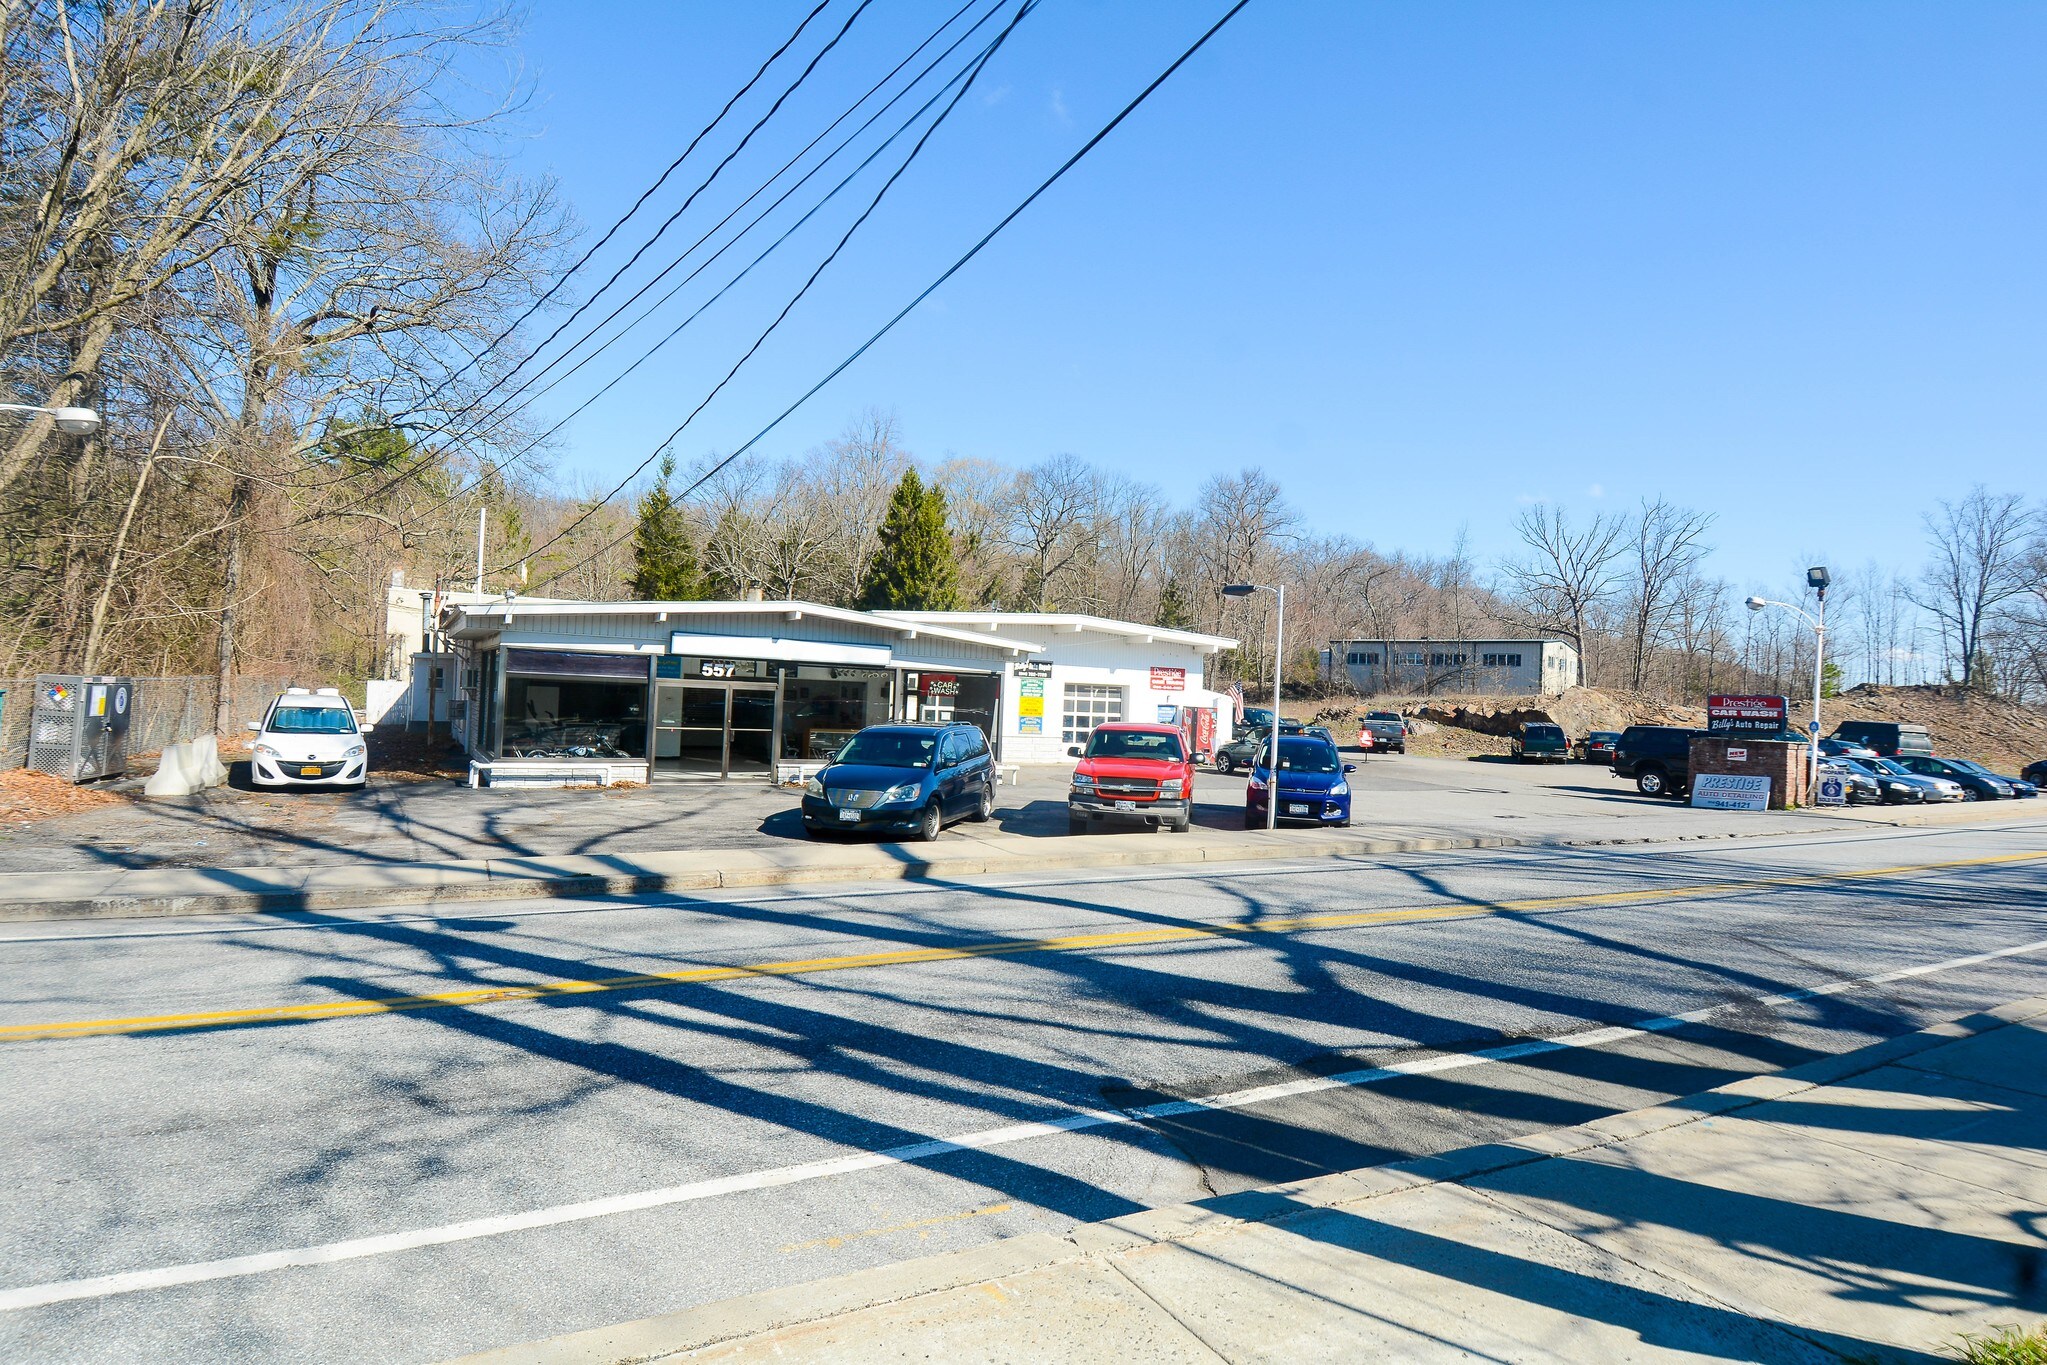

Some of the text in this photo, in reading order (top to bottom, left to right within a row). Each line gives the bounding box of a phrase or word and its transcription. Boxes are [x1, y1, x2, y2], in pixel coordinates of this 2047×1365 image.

[701, 662, 735, 677] 557
[937, 681, 953, 689] CAR
[1723, 698, 1767, 709] Prestige
[1711, 719, 1779, 730] Billy's Auto Repair
[1702, 776, 1762, 791] PRESTIGE
[1721, 791, 1765, 800] DETAILING
[1714, 800, 1751, 808] 941-4121
